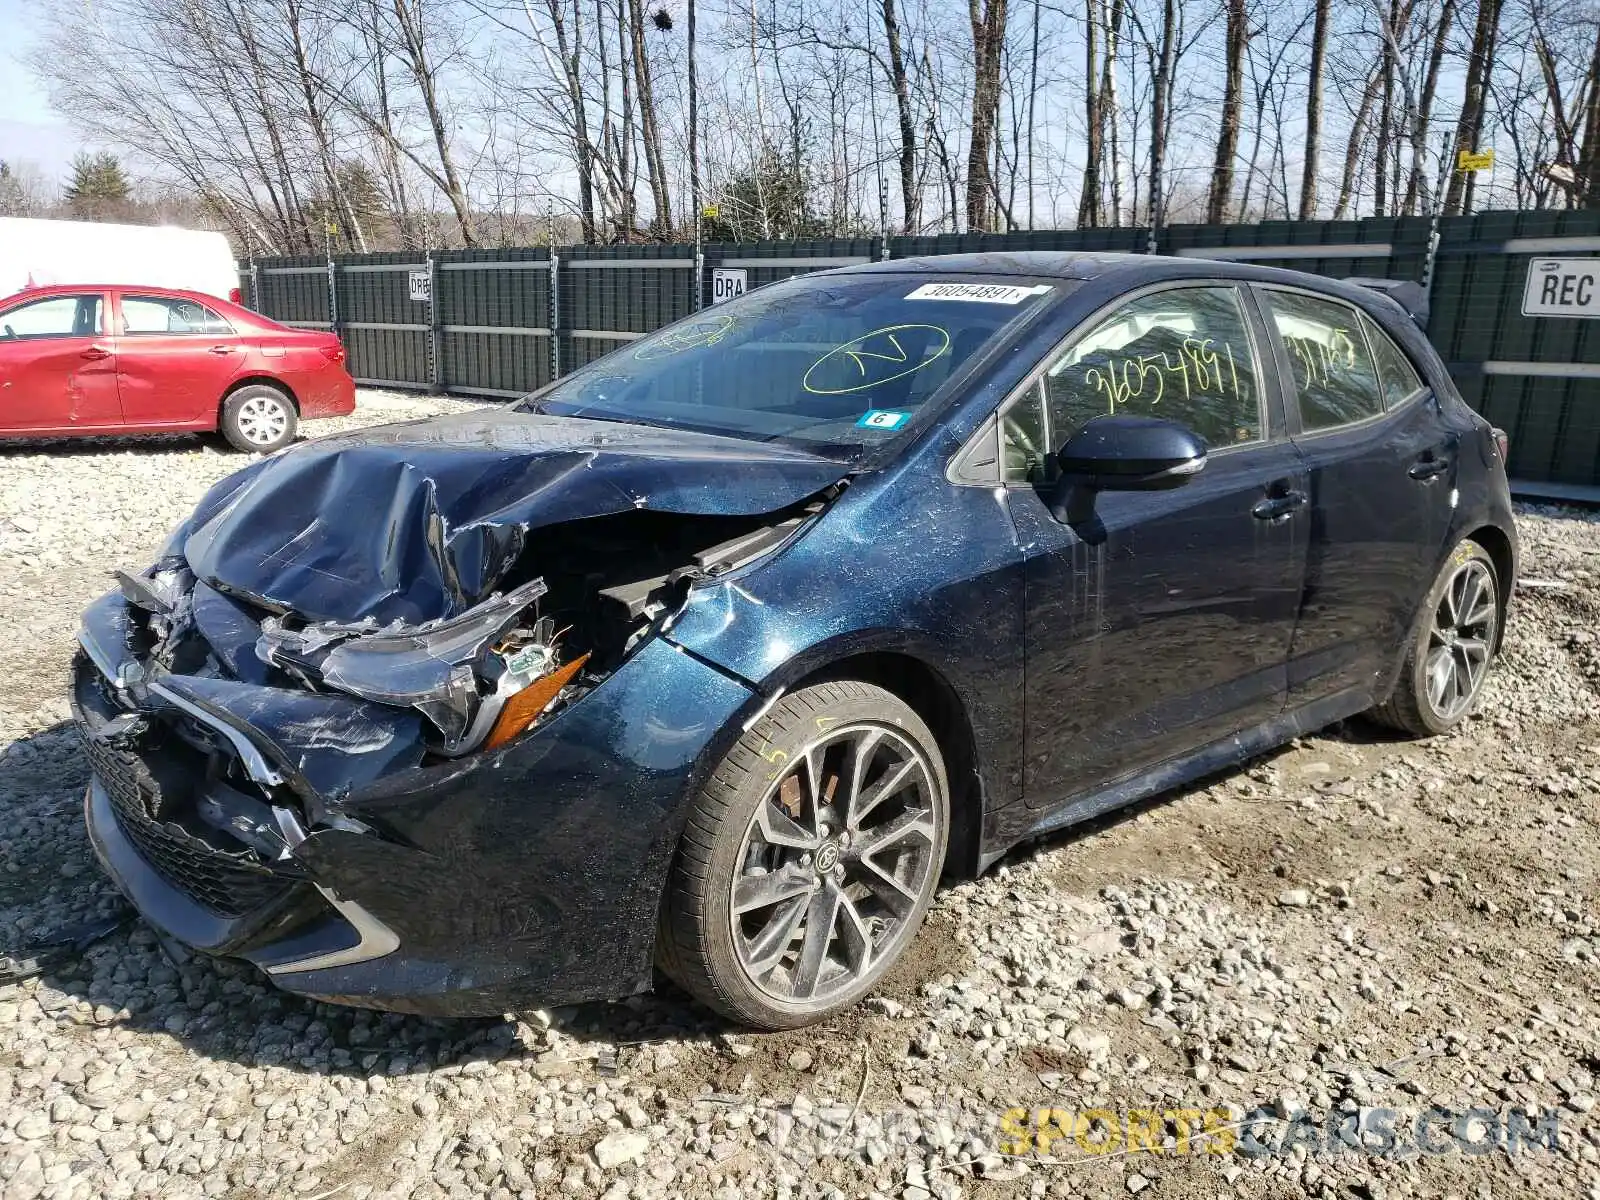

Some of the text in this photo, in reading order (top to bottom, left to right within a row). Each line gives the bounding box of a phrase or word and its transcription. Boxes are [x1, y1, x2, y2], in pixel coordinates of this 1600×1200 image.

[716, 278, 743, 297] DRA
[924, 285, 1016, 299] 36054891
[1540, 275, 1595, 306] REC
[1086, 338, 1239, 414] 36054891
[873, 413, 888, 424] 6
